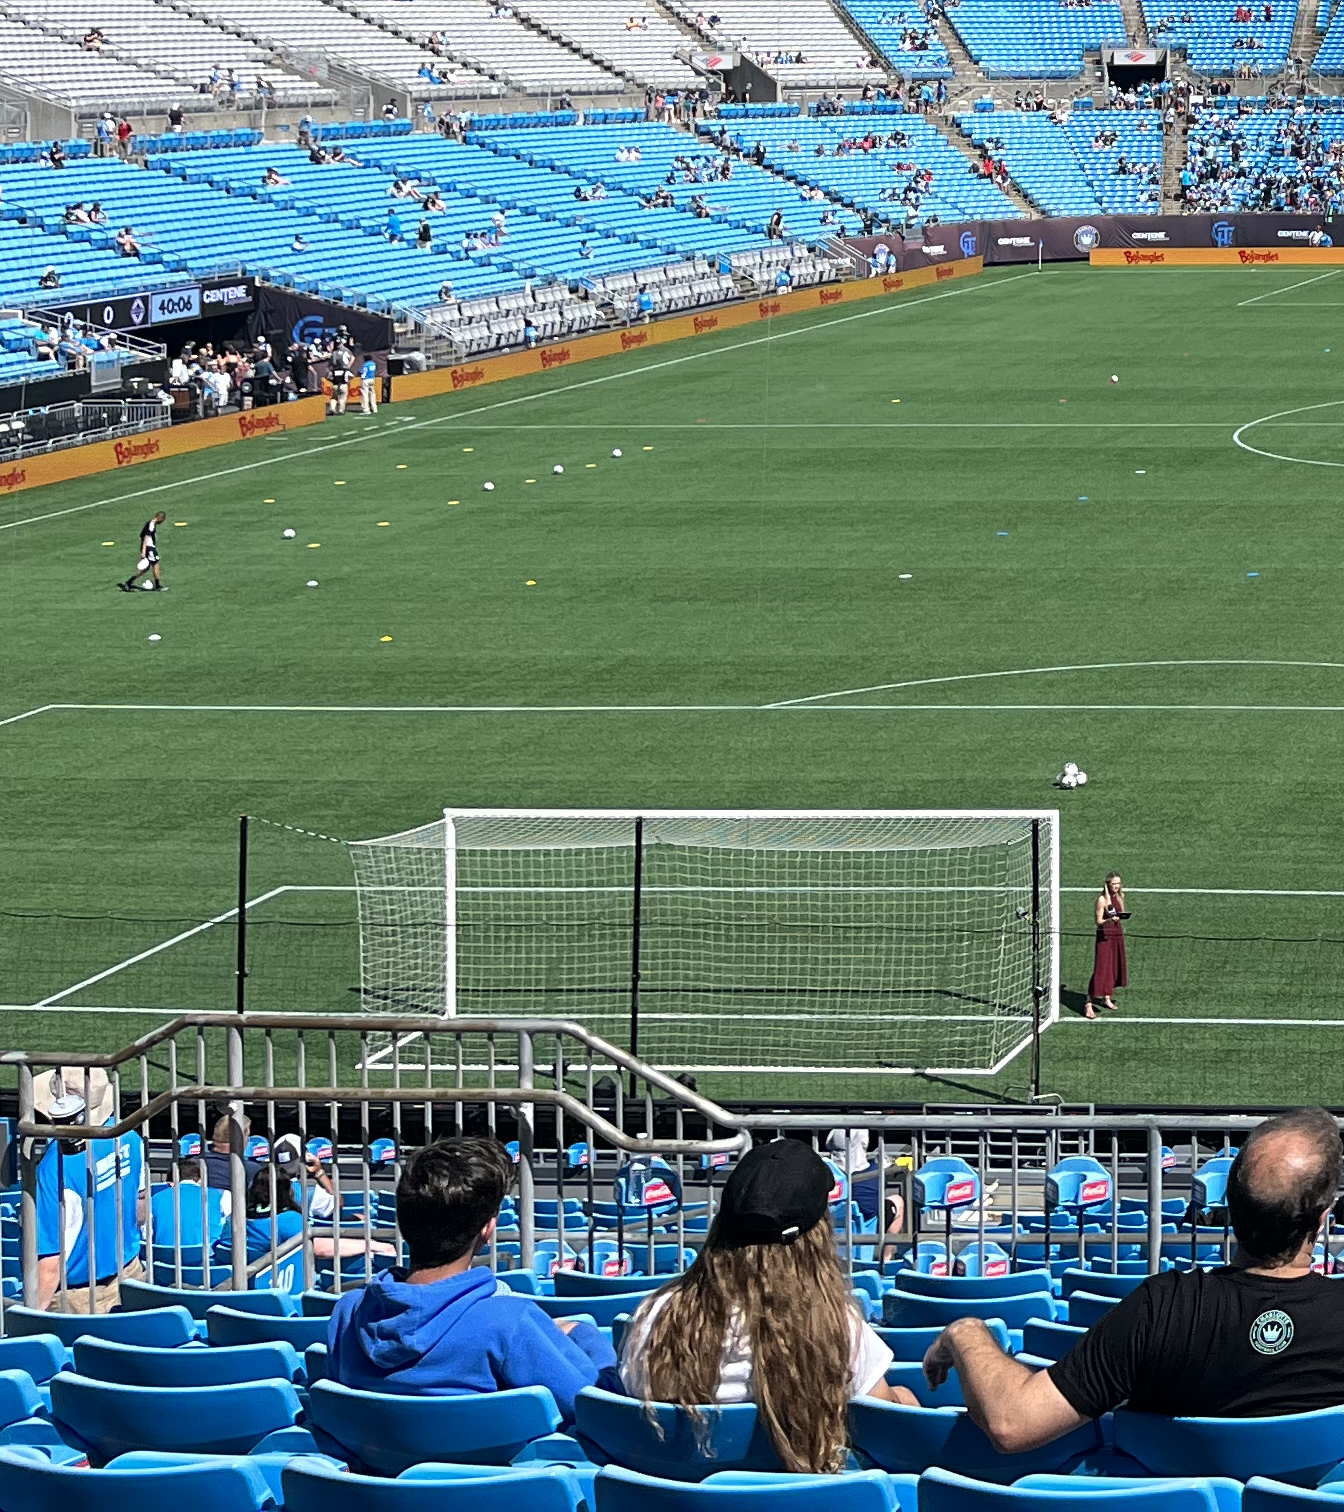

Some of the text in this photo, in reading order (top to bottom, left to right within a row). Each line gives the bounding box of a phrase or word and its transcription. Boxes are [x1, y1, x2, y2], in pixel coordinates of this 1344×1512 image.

[1124, 251, 1164, 264] Bojangles
[203, 285, 248, 304] CENTENE
[103, 305, 114, 325] 0
[158, 296, 193, 316] 40:06
[114, 438, 160, 465] Bojangles
